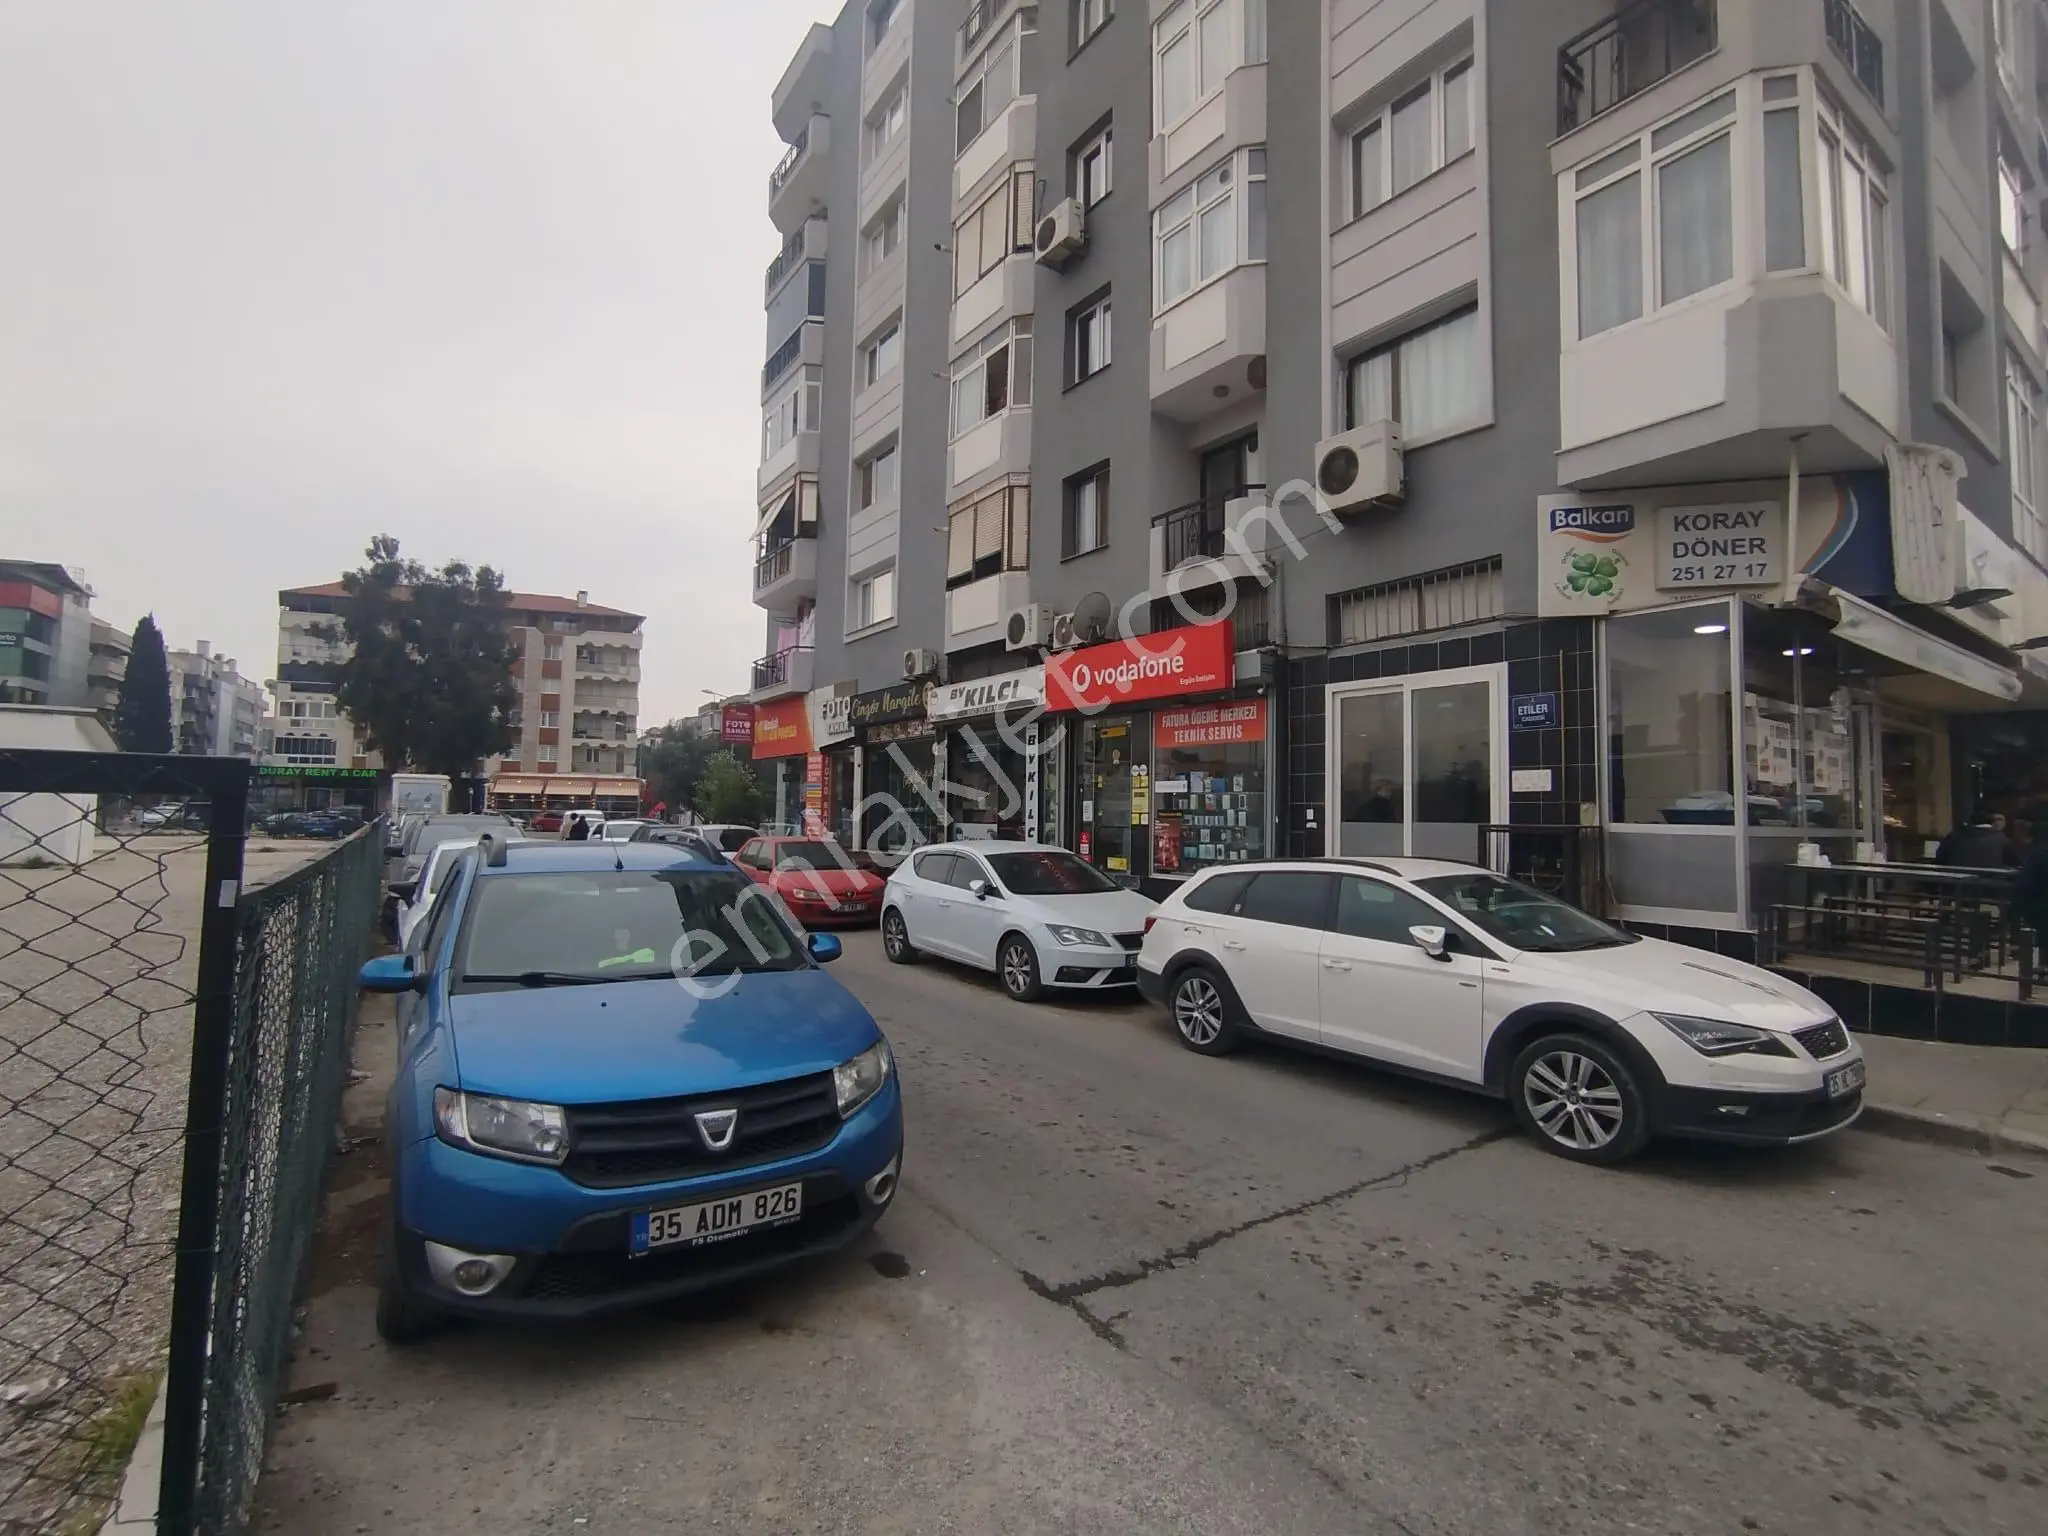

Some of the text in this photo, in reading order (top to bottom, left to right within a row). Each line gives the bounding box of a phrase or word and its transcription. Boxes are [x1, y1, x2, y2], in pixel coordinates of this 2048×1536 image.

[1555, 508, 1629, 527] Balkan
[1673, 510, 1766, 532] KORAY
[1672, 537, 1767, 559] DÖNER
[1672, 563, 1767, 581] 251 27 17
[1094, 655, 1184, 686] vodafone
[950, 686, 966, 700] BY
[820, 696, 850, 720] FOTO
[1162, 705, 1257, 728] FATURA ÖDEME MERKEZİ
[1517, 703, 1548, 716] ETİLER
[725, 719, 751, 729] FOTO
[725, 728, 751, 736] BAHAR
[1174, 724, 1243, 743] TEKNİK SERVİS
[259, 767, 377, 778] DURAY RENT A CAR
[1027, 734, 1037, 838] BYKILC
[650, 1188, 798, 1242] 35 ADM 826
[706, 1228, 749, 1243] Otomotiv
